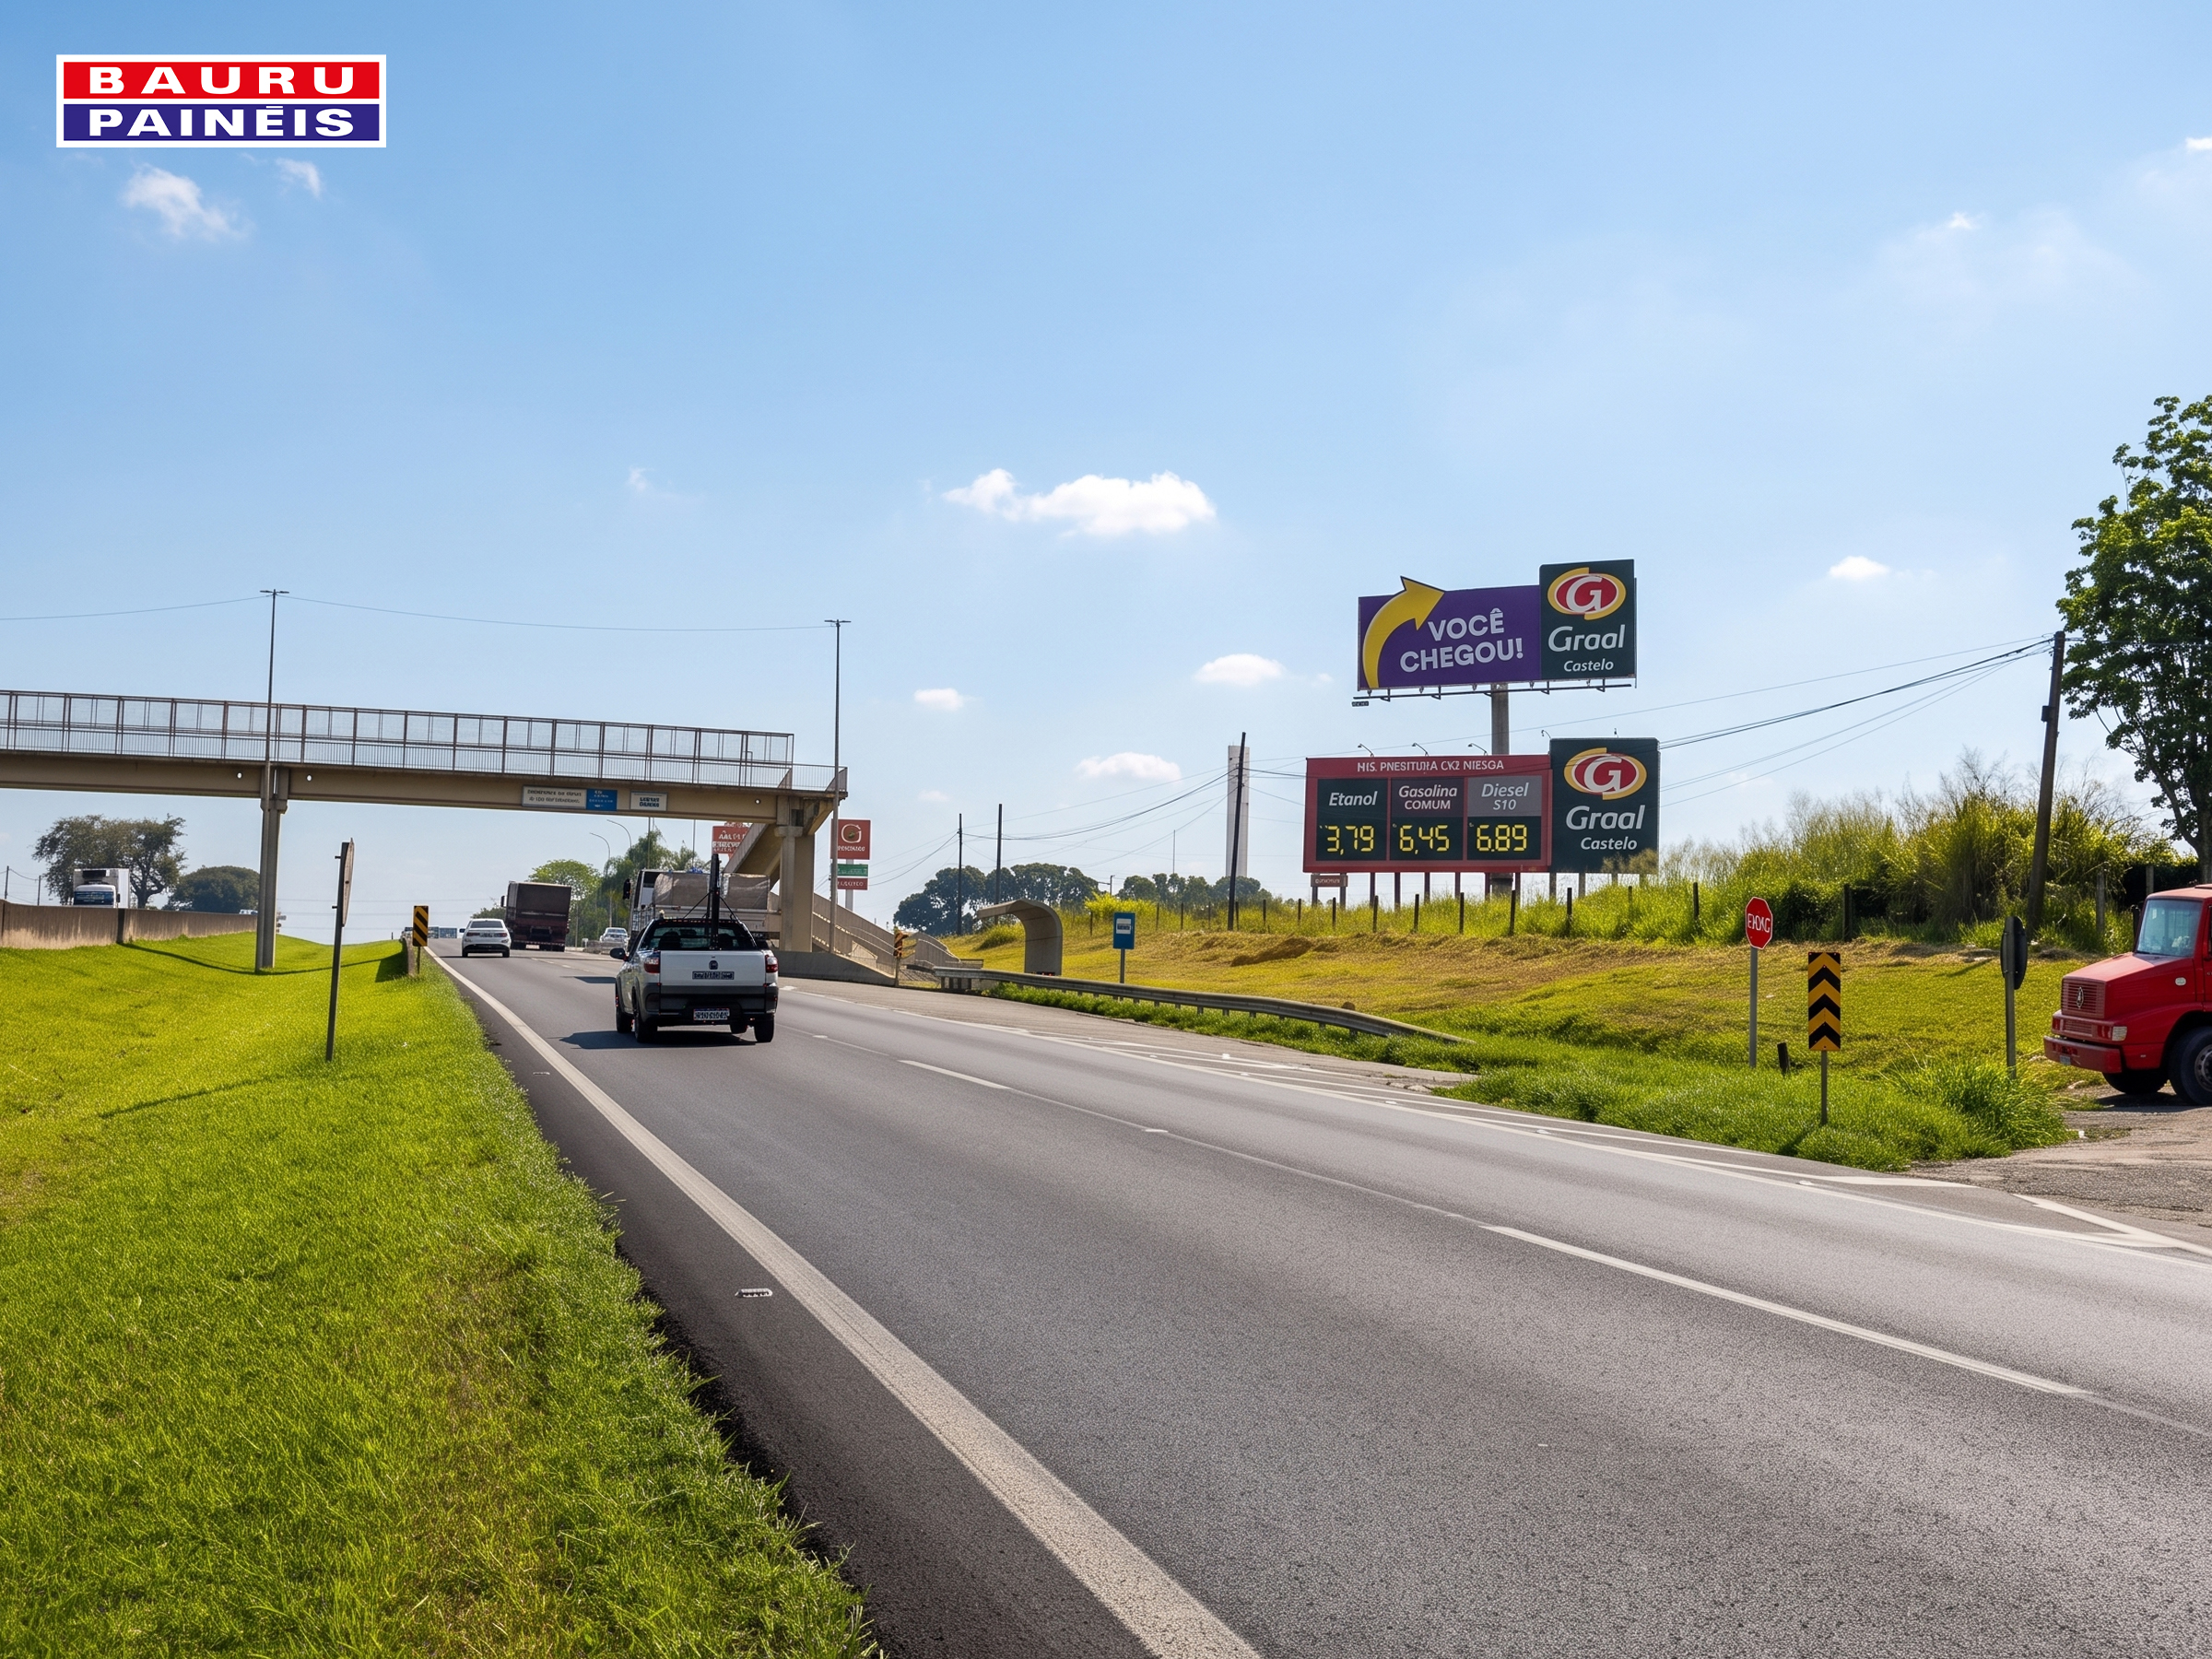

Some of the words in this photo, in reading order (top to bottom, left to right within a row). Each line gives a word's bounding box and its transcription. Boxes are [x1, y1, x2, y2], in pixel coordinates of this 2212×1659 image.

[1428, 607, 1504, 641] VOCÊ
[1548, 624, 1625, 652] Graal
[1400, 638, 1524, 673] CHEGOU!
[1564, 658, 1614, 672] Castelo
[1398, 784, 1458, 798] Gasolina
[1481, 782, 1529, 797] Diesel
[1329, 791, 1378, 806] Etanol
[1404, 800, 1451, 810] COMUM
[1493, 799, 1516, 810] S10
[1566, 805, 1646, 830] Graal
[1327, 825, 1374, 855] 3,79
[1399, 824, 1450, 854] 6,45
[1581, 836, 1638, 850] Castelo
